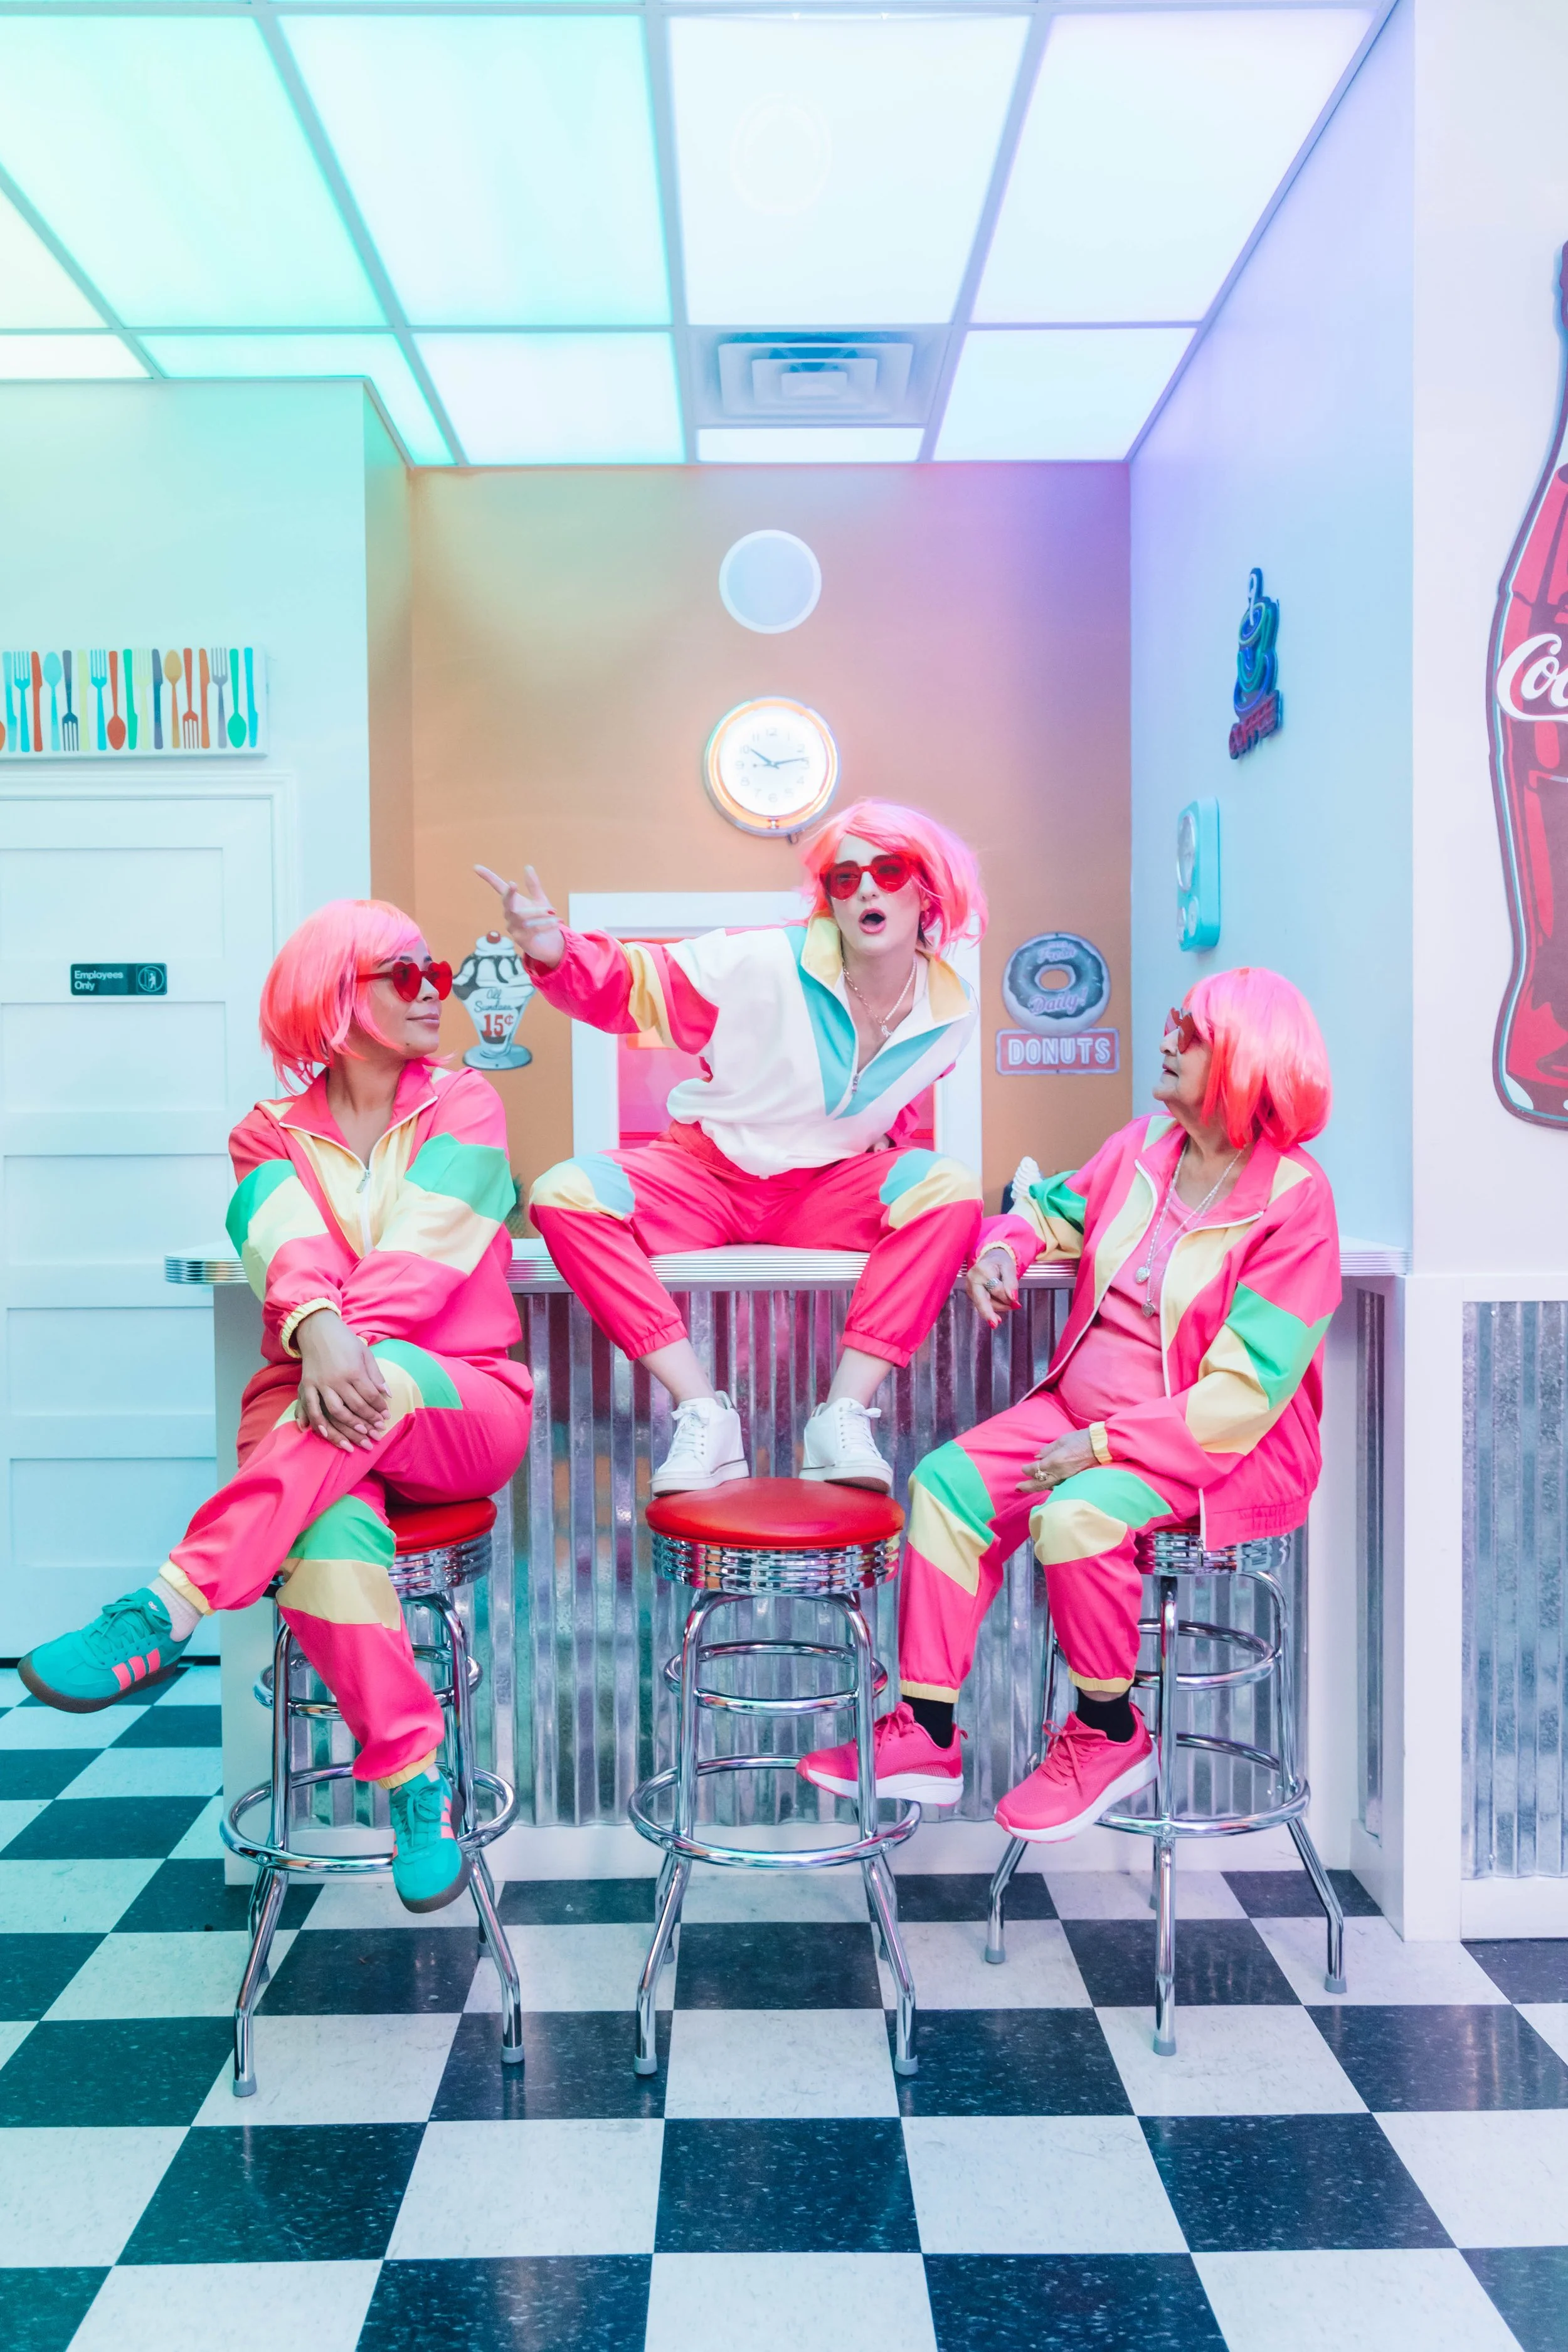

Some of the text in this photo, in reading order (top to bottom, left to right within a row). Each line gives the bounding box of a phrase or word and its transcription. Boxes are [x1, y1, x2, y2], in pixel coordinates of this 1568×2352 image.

[752, 732, 760, 741] 11
[765, 727, 778, 737] 12
[739, 744, 750, 754] 10
[796, 743, 805, 753] 2
[735, 760, 744, 770] 9
[800, 758, 810, 770] 3
[741, 776, 750, 786] 8
[797, 775, 805, 785] 4
[754, 788, 762, 798] 7
[785, 788, 793, 797] 5
[768, 793, 778, 803] 6
[74, 970, 124, 980] Employees
[74, 981, 95, 991] Only
[486, 988, 502, 999] All
[1029, 987, 1088, 1015] Daily!
[482, 1014, 514, 1037] 15¢
[1008, 1037, 1111, 1065] DONUTS
